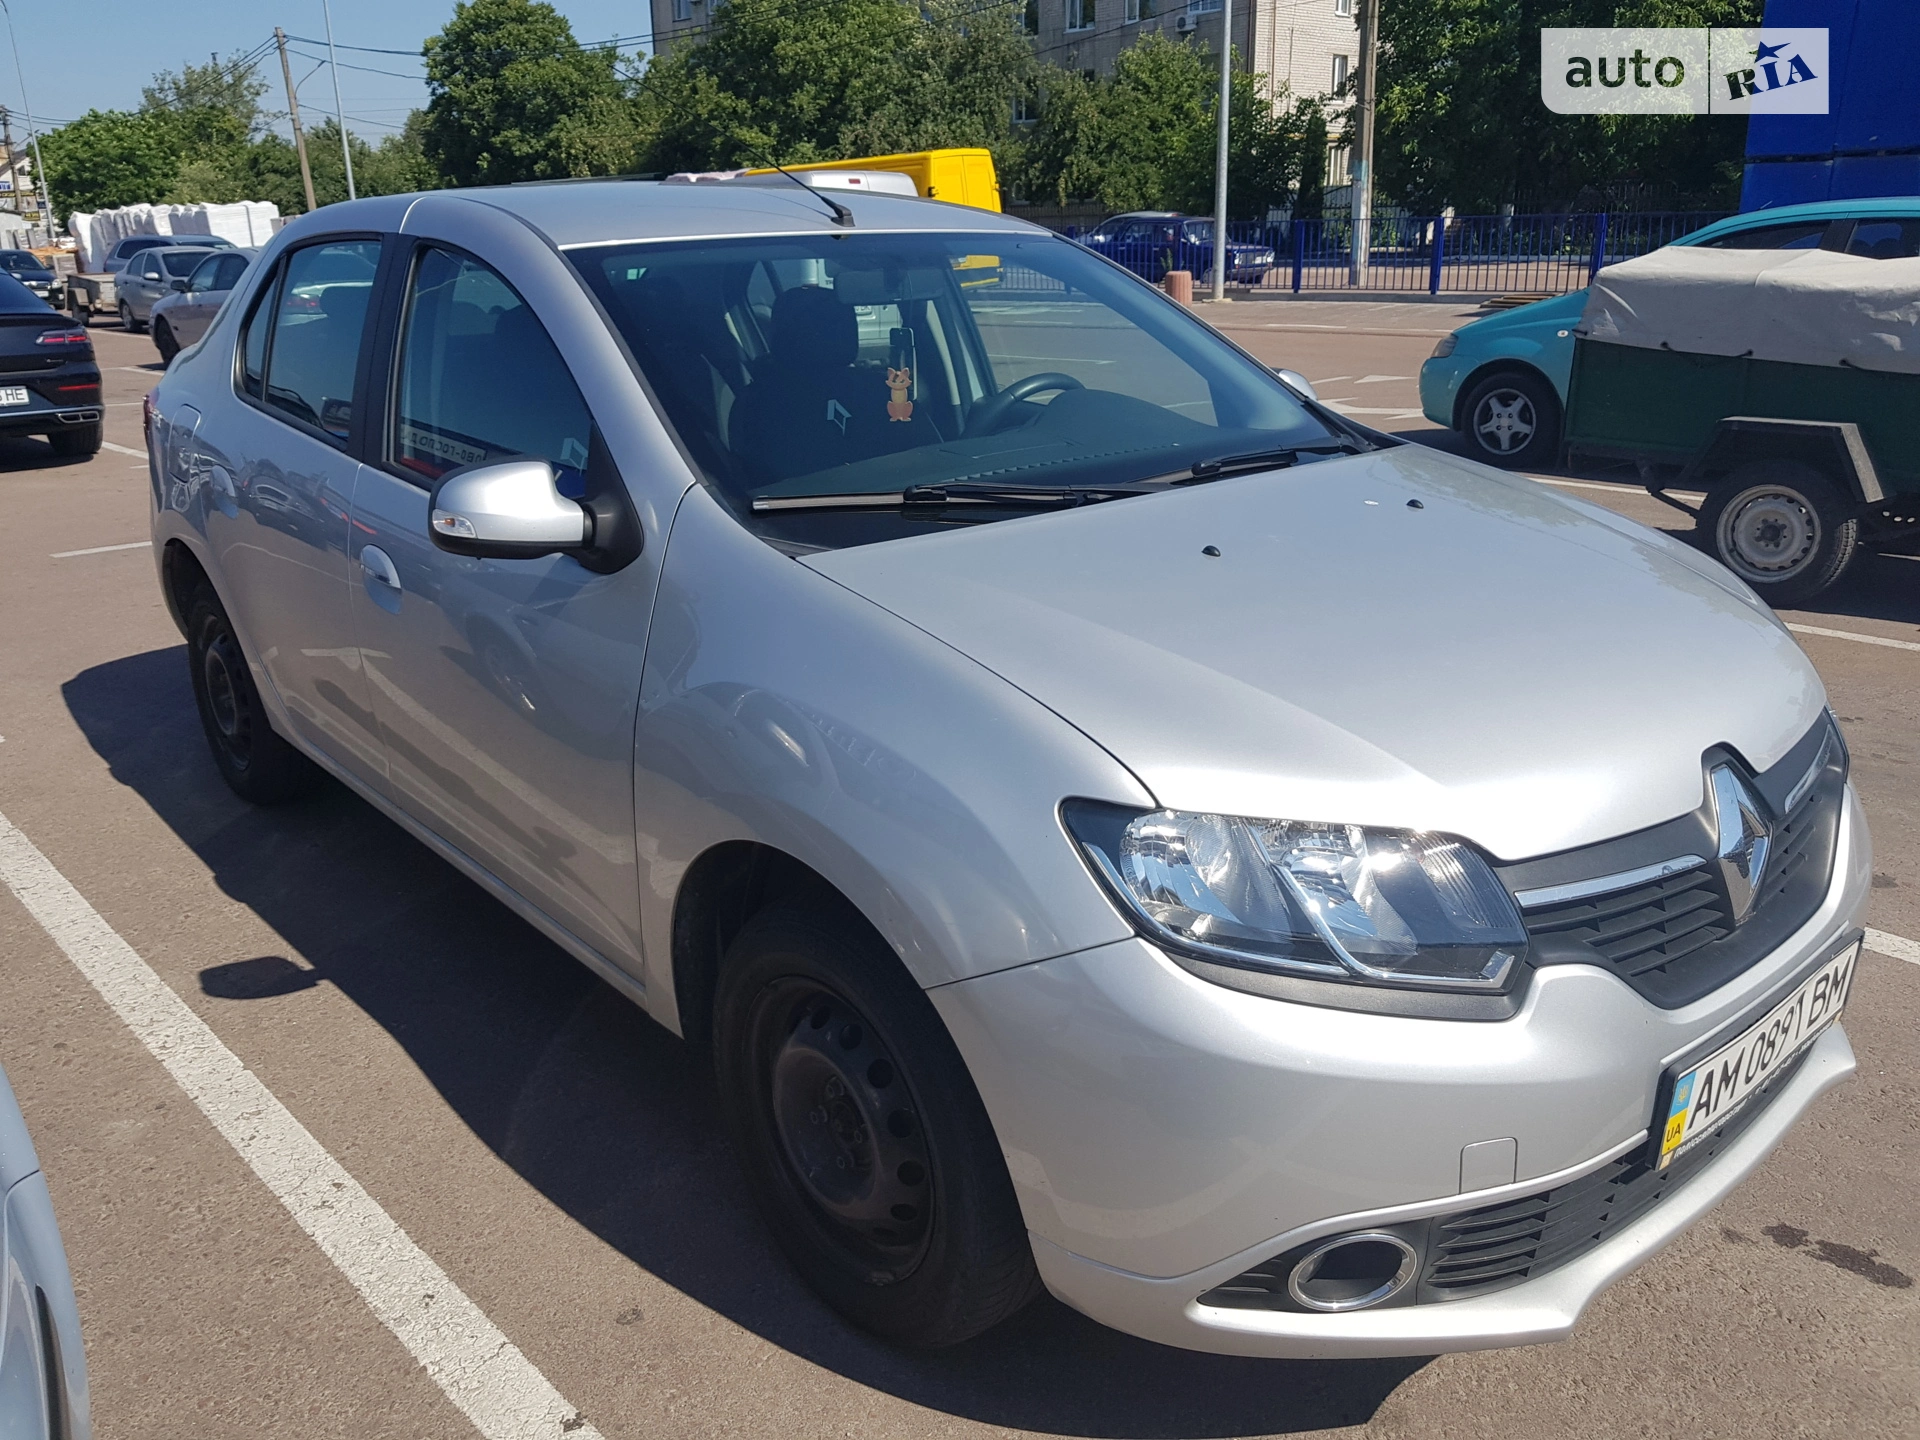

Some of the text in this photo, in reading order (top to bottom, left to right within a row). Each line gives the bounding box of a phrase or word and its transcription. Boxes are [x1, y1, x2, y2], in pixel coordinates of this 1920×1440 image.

[5, 388, 25, 401] HE
[1687, 1046, 1745, 1130] AM
[1745, 990, 1806, 1085] 0891
[1807, 954, 1851, 1029] BM
[1666, 1122, 1681, 1143] UA
